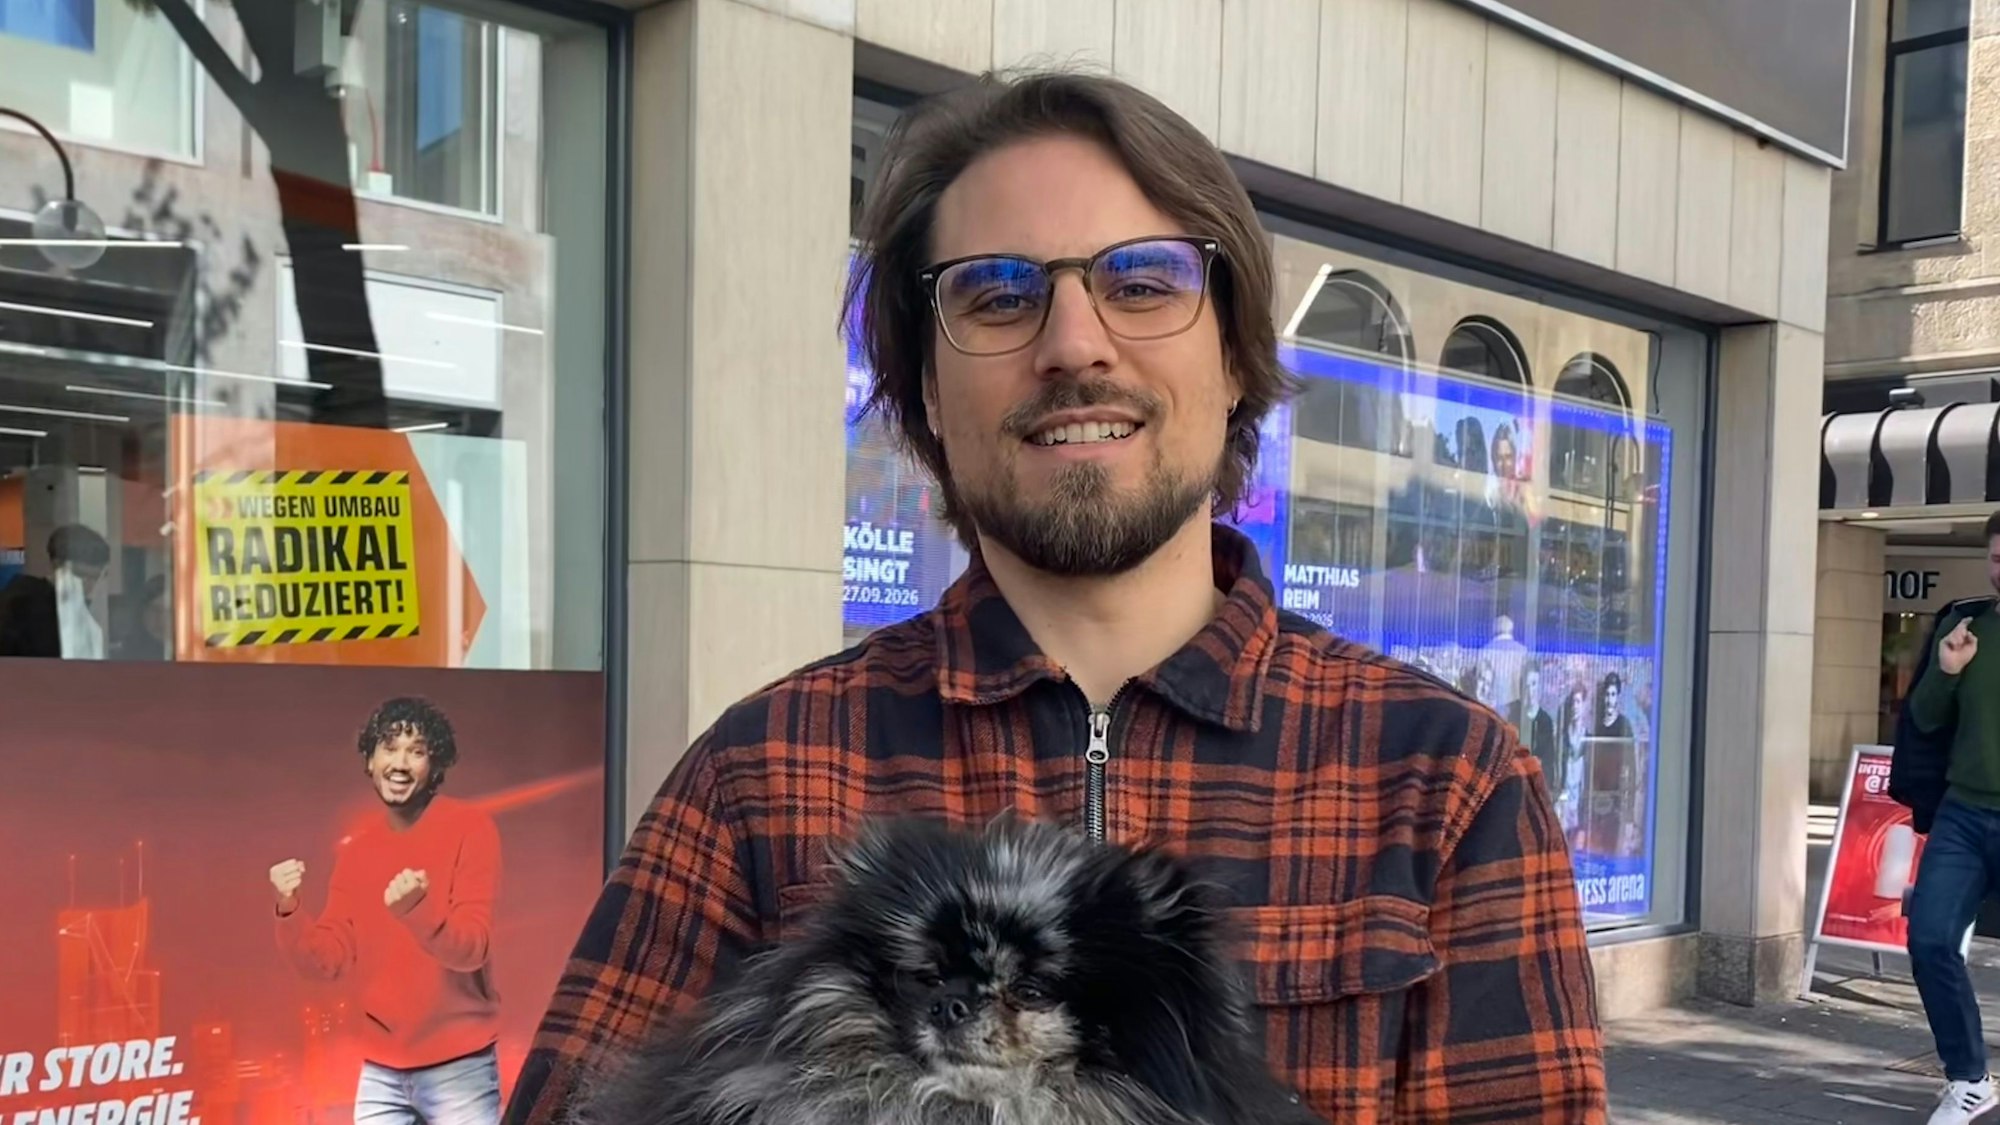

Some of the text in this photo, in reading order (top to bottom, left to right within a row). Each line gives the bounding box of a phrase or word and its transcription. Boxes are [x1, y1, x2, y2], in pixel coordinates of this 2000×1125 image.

[239, 495, 401, 519] WEGEN UMBAU
[206, 525, 407, 575] RADIKAL
[843, 521, 914, 554] KÖLLE
[843, 556, 910, 584] SINGT
[1284, 564, 1359, 588] MATTHIAS
[210, 579, 404, 621] REDUZIERT!
[843, 585, 919, 606] 27.09.2026
[1283, 587, 1320, 610] REIM
[1607, 872, 1645, 904] arena
[38, 1036, 184, 1092] STORE.
